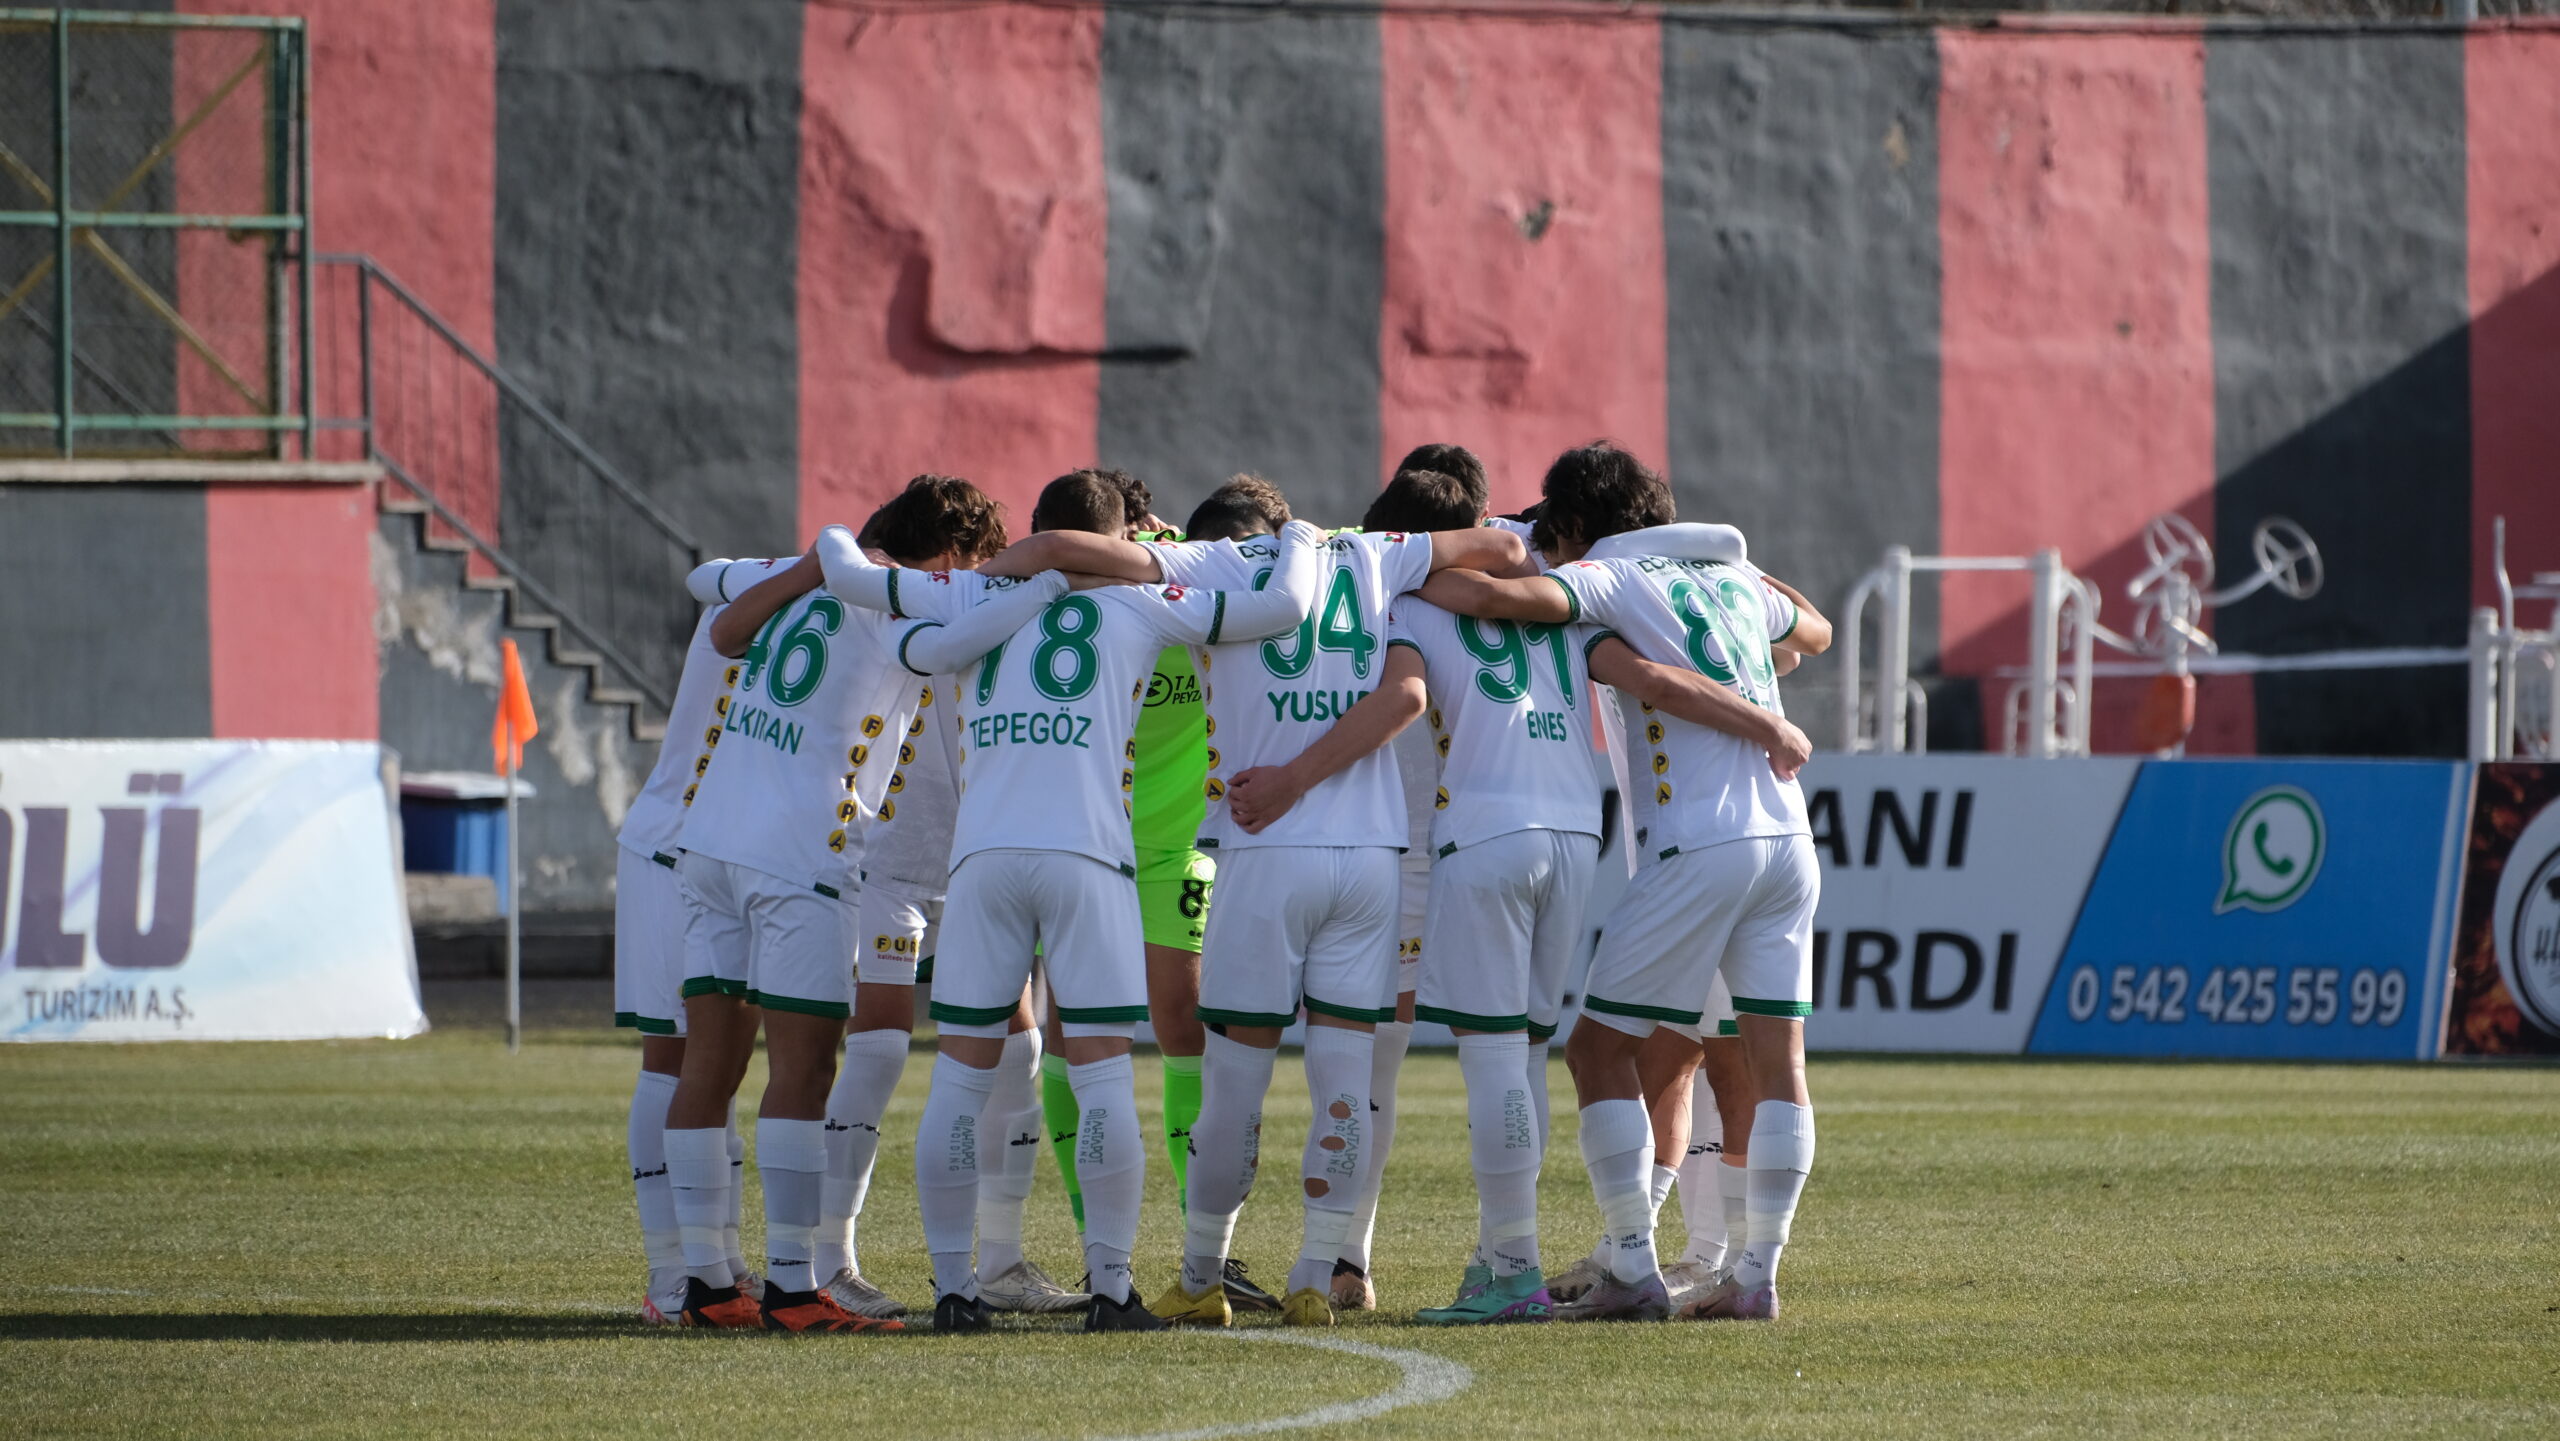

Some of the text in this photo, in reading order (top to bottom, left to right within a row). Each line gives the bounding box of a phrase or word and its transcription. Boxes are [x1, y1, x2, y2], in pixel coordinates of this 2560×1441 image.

[742, 596, 845, 707] 46
[1455, 613, 1575, 711] 91
[969, 706, 1092, 751] TEPEGÖZ
[1267, 690, 1371, 722] YUSU
[1526, 710, 1567, 742] ENES
[0, 773, 203, 969] LÜ
[24, 979, 137, 1022] TURİZİM
[2068, 964, 2406, 1026] 0 542 425 55 99
[949, 1126, 961, 1171] HOLDING
[1079, 1120, 1091, 1164] HOLDING
[1621, 1239, 1650, 1249] PLUS
